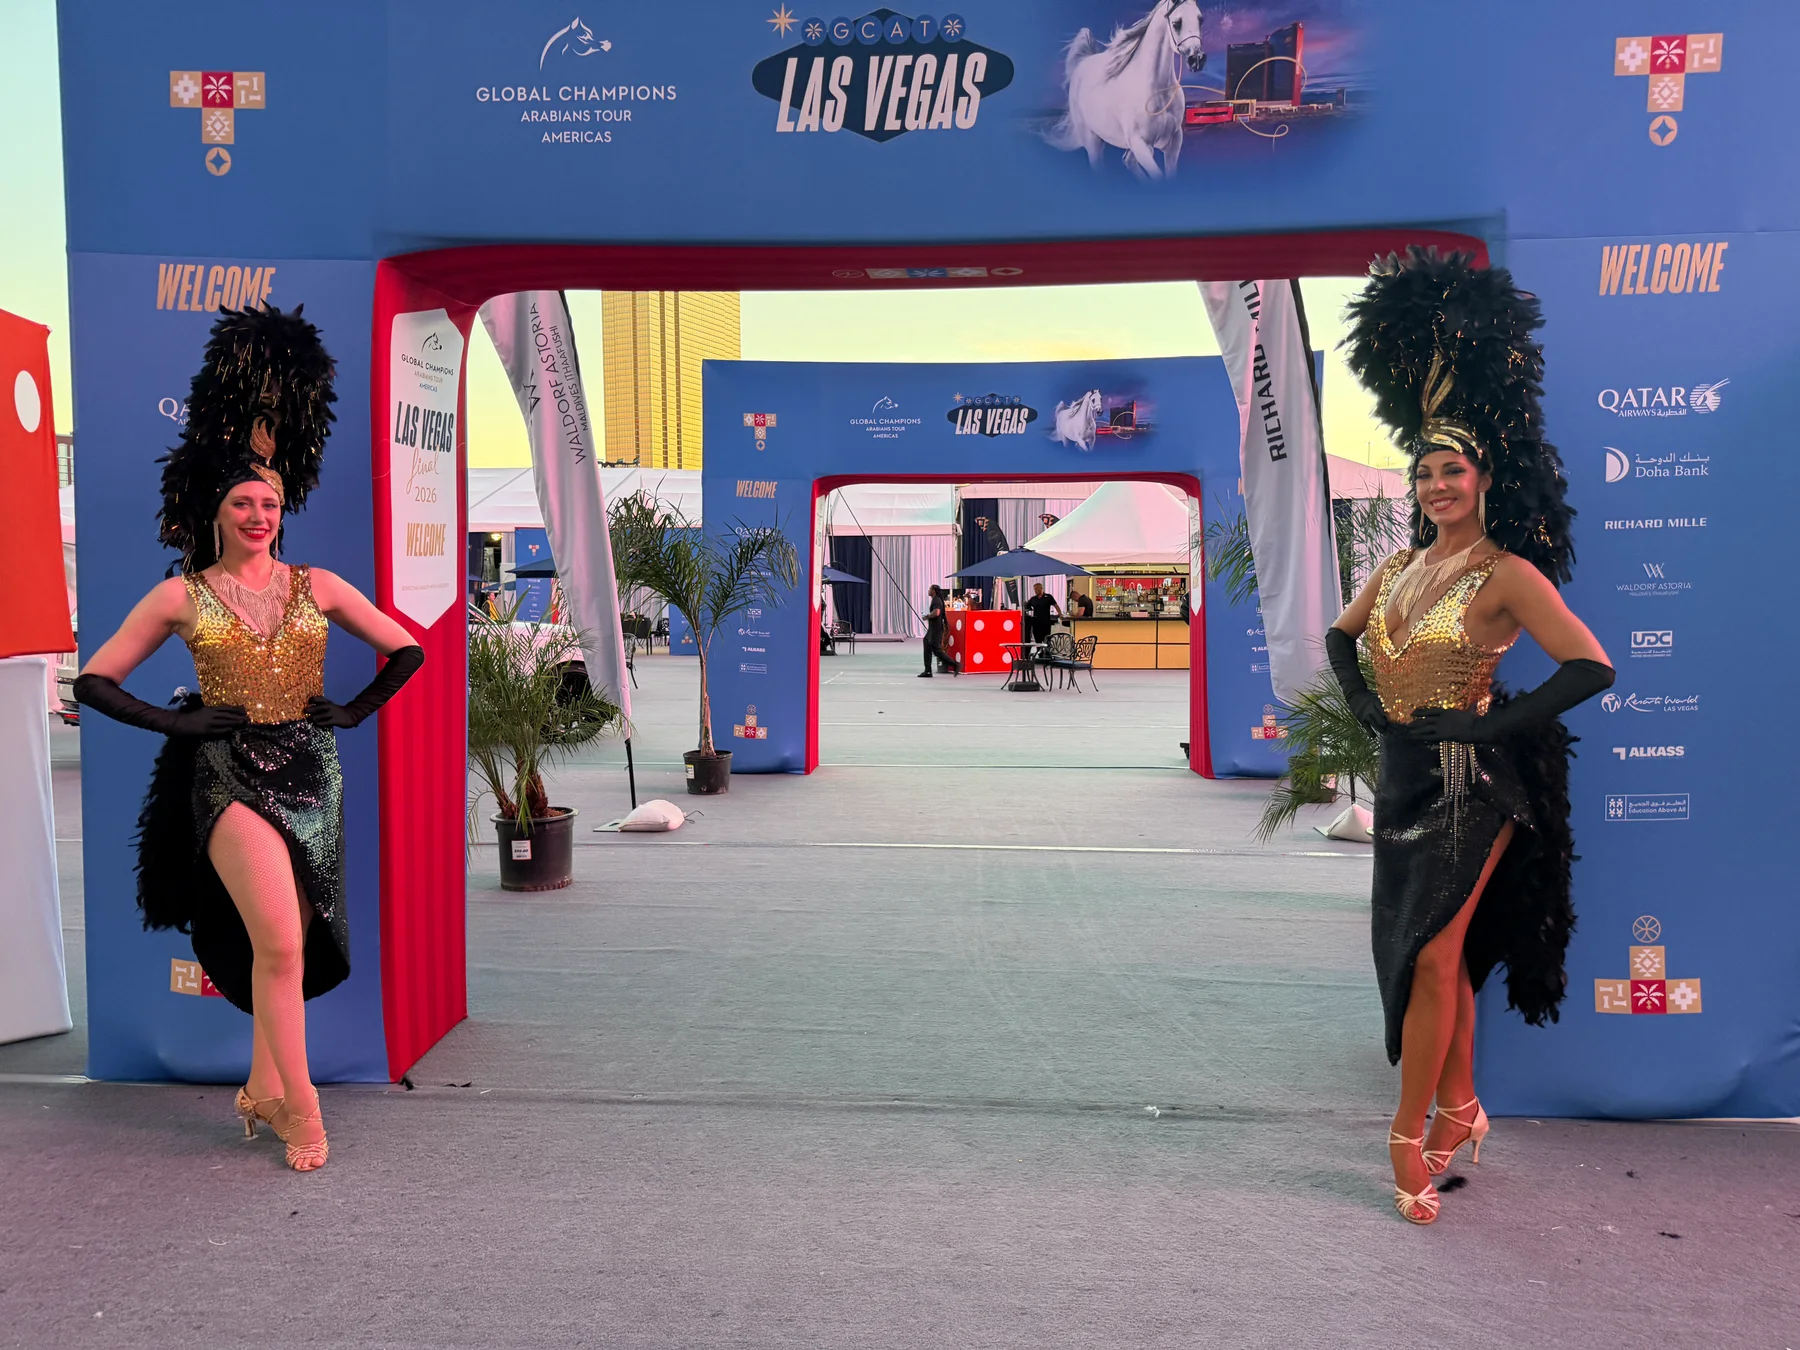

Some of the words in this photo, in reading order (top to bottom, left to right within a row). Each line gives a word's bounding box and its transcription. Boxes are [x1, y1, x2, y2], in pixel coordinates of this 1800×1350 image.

[476, 86, 551, 101] GLOBAL
[558, 85, 677, 101] CHAMPIONS
[775, 56, 853, 132] LAS
[864, 52, 988, 131] VEGAS
[520, 110, 590, 122] ARABIANS
[594, 110, 632, 122] TOUR
[541, 131, 612, 143] AMERICAS
[1599, 242, 1728, 296] WELCOME
[156, 263, 276, 313] WELCOME
[529, 302, 560, 374] ASTORIA
[401, 353, 424, 369] GLOBAL
[425, 362, 454, 376] CHAMPIONS
[549, 325, 574, 382] ITHAAFUSHI
[419, 382, 438, 392] AMERICAS
[569, 383, 588, 432] MALDIVES
[1253, 343, 1287, 462] RICHARD
[1598, 386, 1687, 414] QATAR
[548, 379, 587, 465] WALDORF
[955, 408, 983, 435] LAS
[986, 407, 1029, 435] VEGAS
[1618, 409, 1656, 418] AIRWAYS
[395, 401, 420, 448] LAS
[421, 408, 455, 453] VEGAS
[406, 444, 439, 494] final
[1635, 465, 1670, 478] Doha
[1674, 464, 1709, 477] Bank
[415, 486, 437, 503] 2026
[736, 480, 778, 499] WELCOME
[1604, 519, 1663, 530] RICHARD
[1667, 517, 1708, 528] MILLE
[406, 522, 447, 557] WELCOME
[1616, 583, 1656, 591] WALDORF
[1658, 582, 1692, 590] ASTORIA
[1633, 632, 1671, 646] UDC
[1629, 745, 1685, 757] ALKASS
